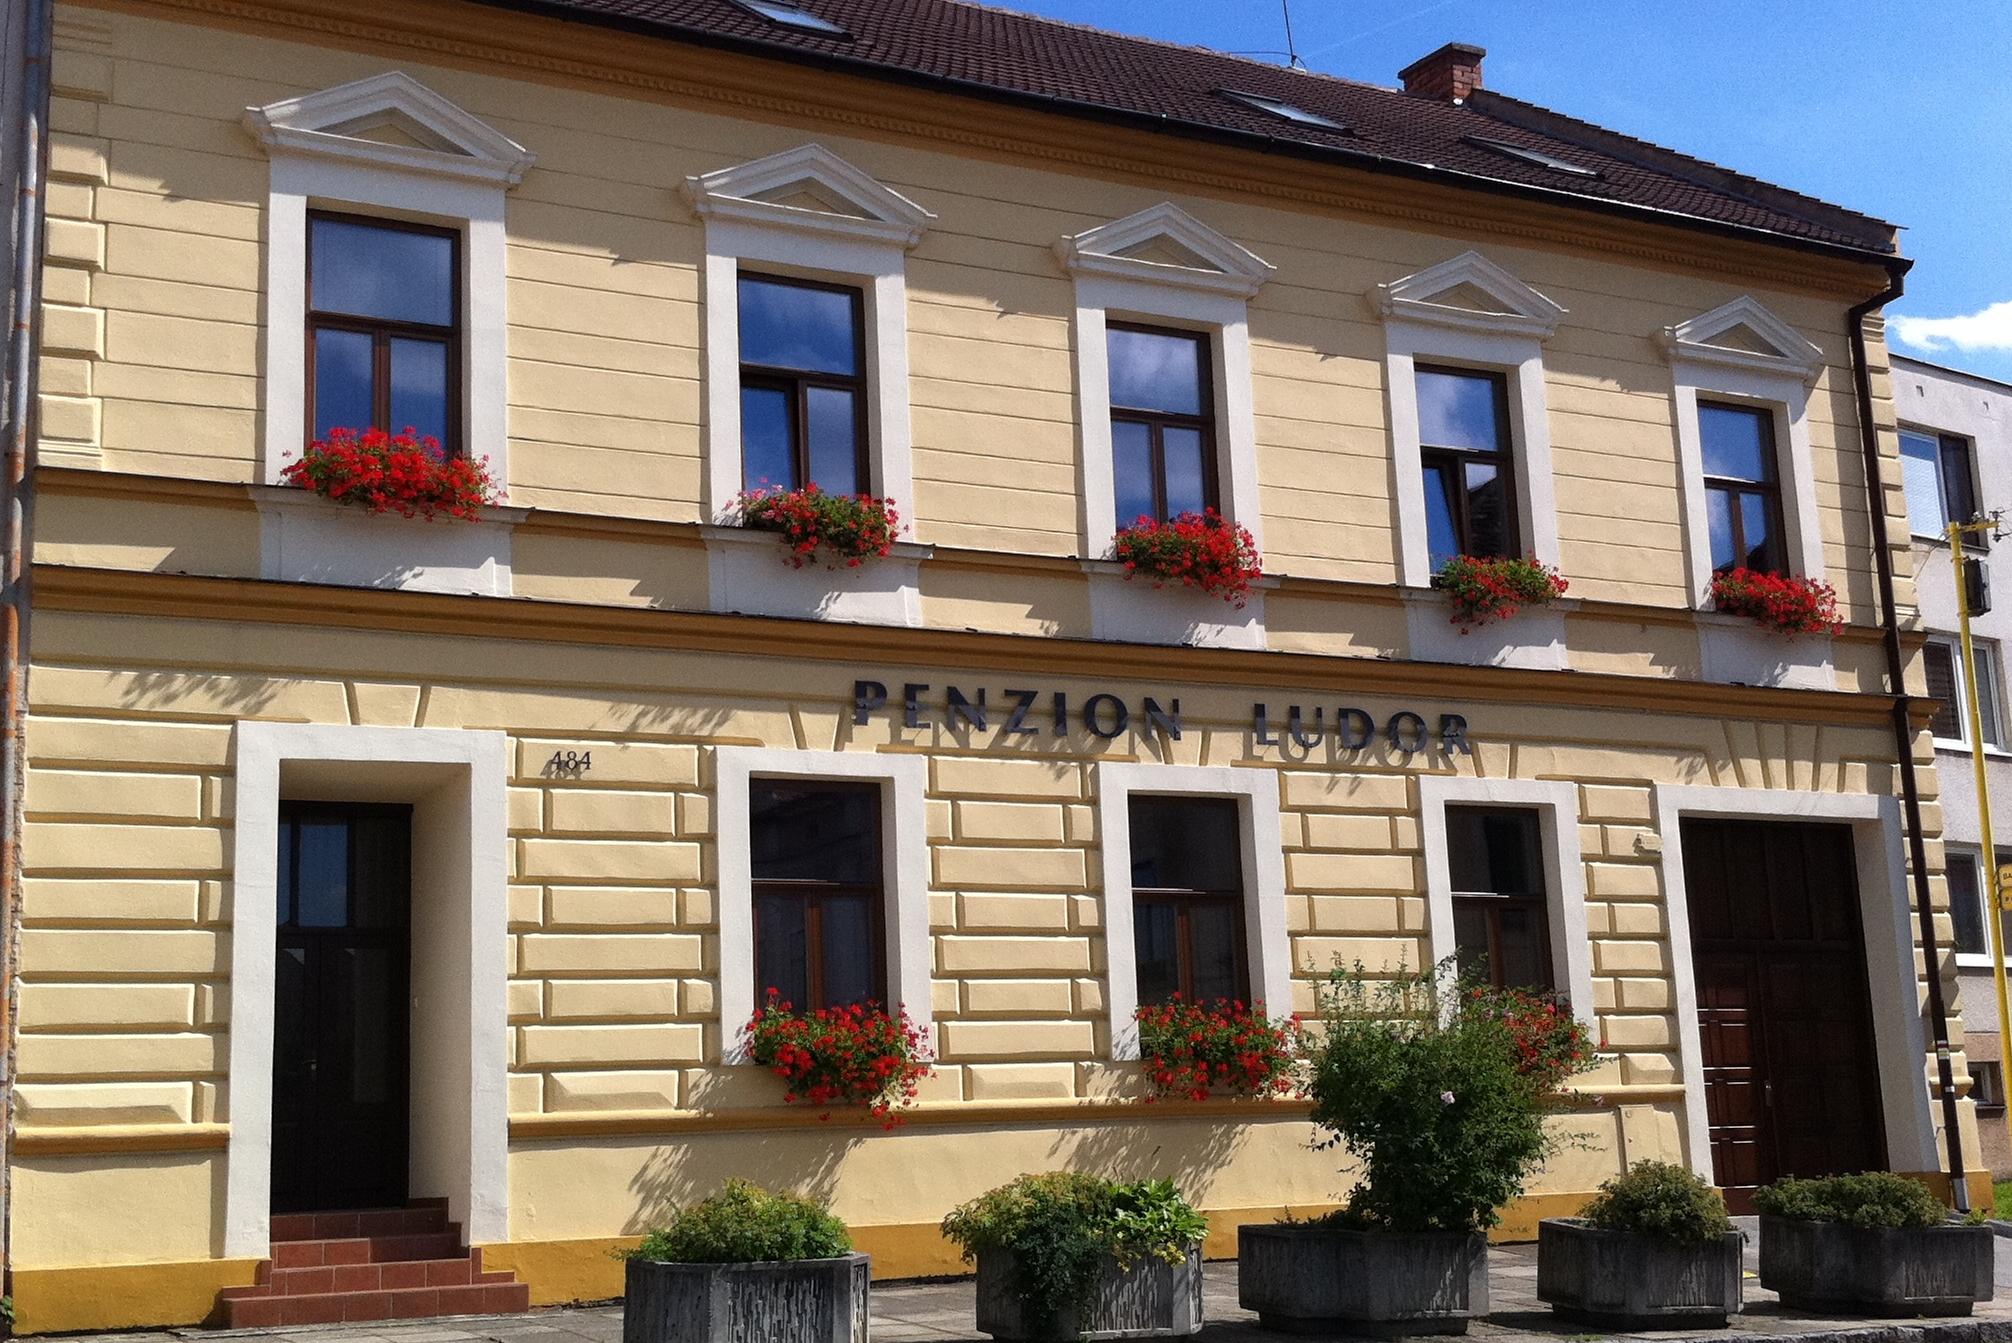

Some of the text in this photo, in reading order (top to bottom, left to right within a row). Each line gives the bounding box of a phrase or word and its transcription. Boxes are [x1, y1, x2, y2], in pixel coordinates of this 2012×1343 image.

[854, 680, 1472, 755] PENZION LUDOR
[551, 750, 592, 771] 484
